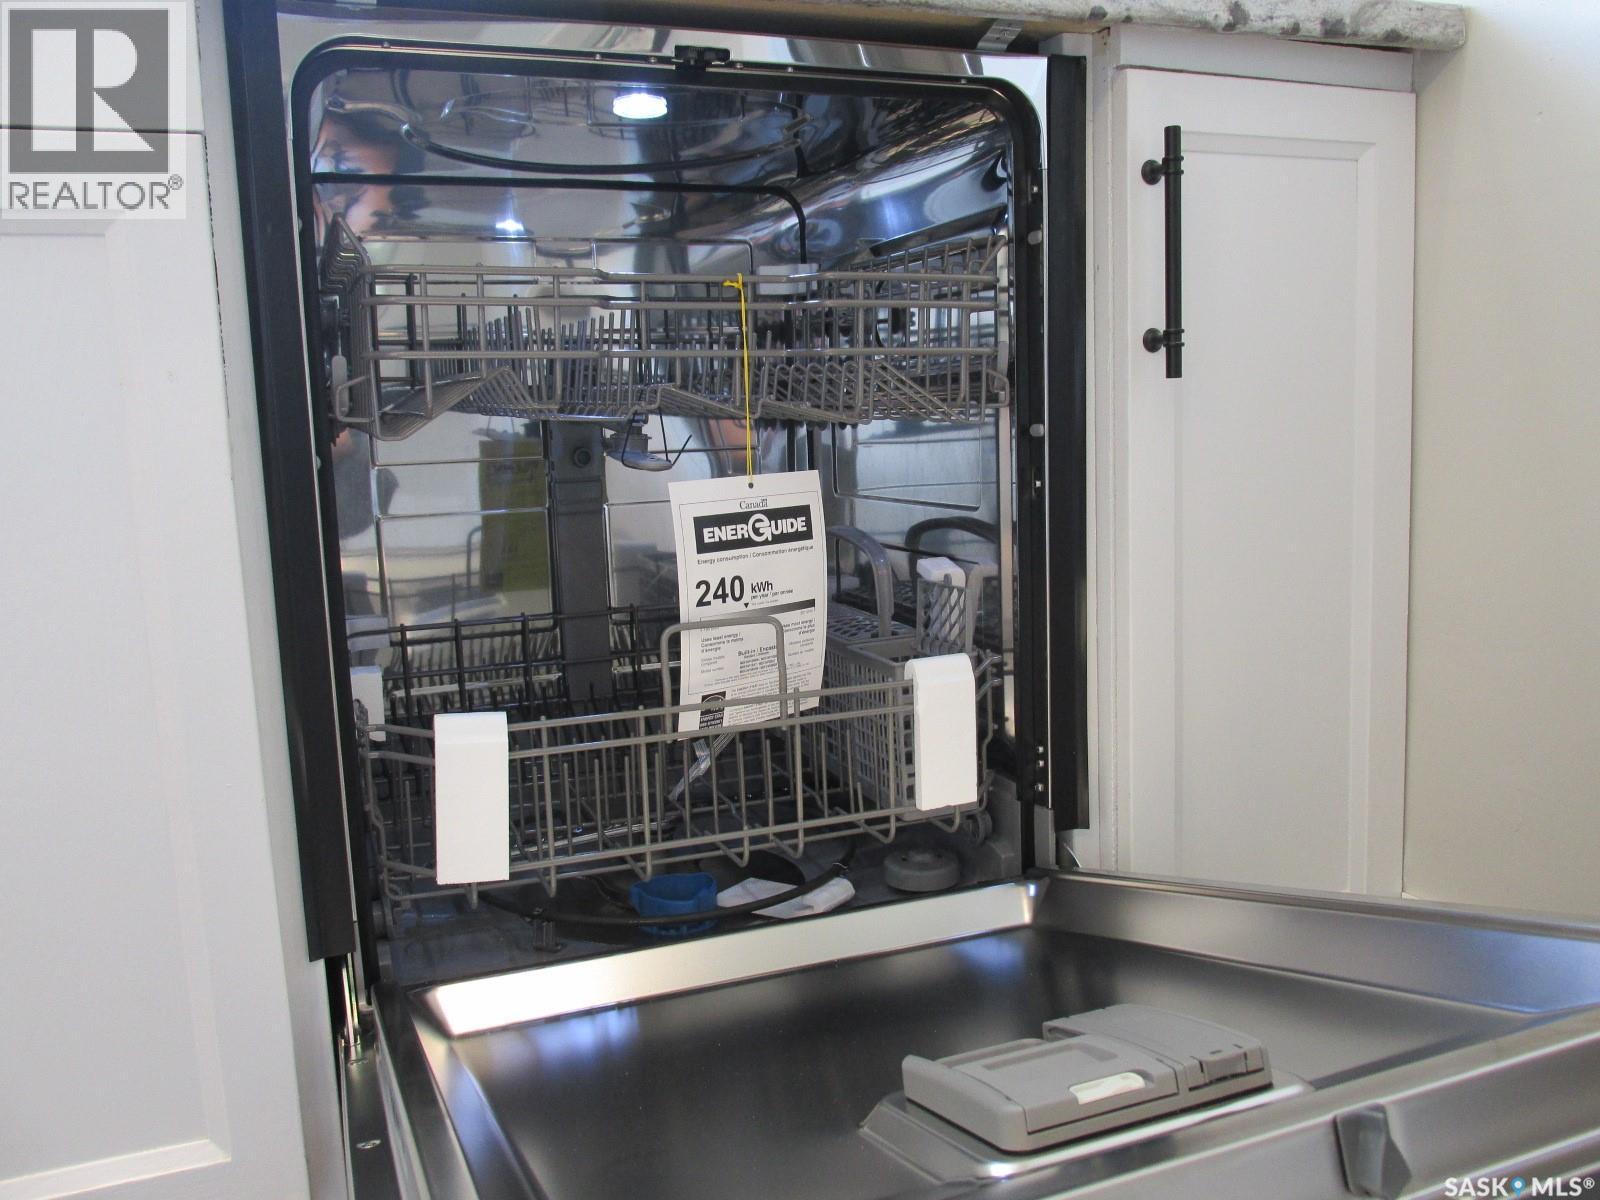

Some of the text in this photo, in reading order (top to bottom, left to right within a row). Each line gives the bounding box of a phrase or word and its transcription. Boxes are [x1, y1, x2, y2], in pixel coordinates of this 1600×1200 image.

[702, 513, 808, 543] ENERGUIDE
[716, 554, 749, 562] consumption
[695, 575, 745, 608] 240
[751, 580, 773, 594] kWh
